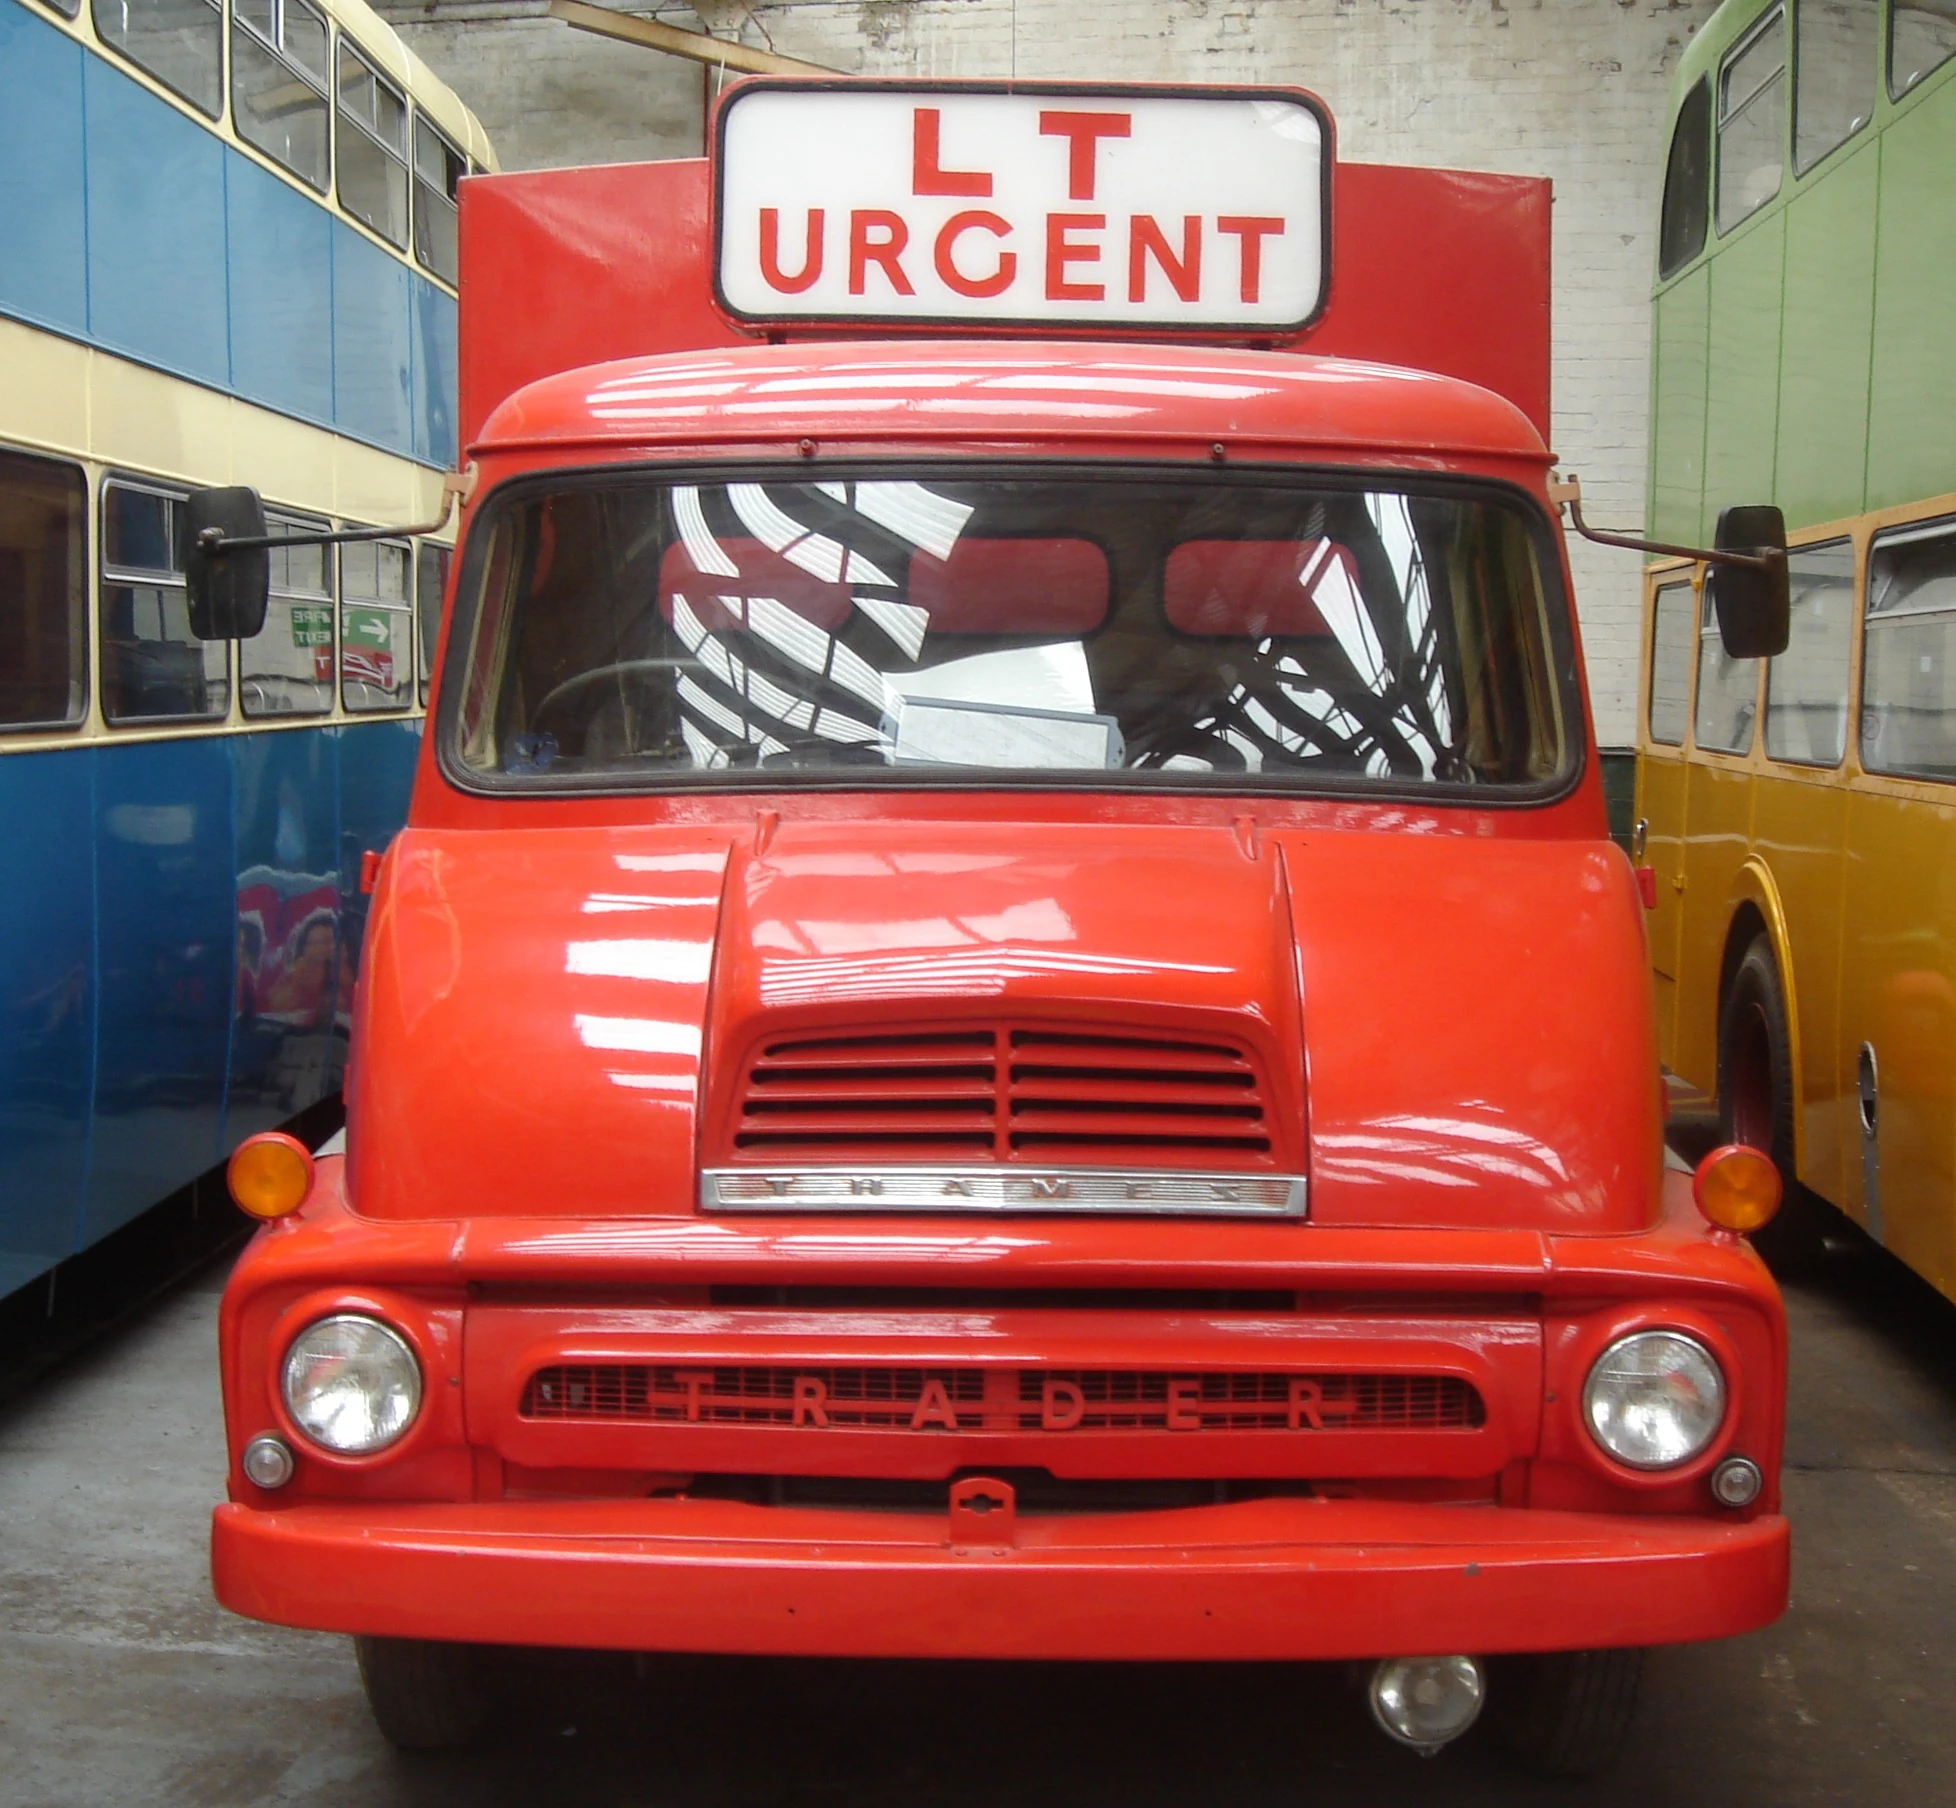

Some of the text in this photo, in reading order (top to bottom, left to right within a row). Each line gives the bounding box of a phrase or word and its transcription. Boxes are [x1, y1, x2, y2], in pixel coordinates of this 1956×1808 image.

[759, 207, 1286, 304] URGENT
[765, 1176, 1241, 1202] THAMES
[673, 1371, 1323, 1430] TRADER
